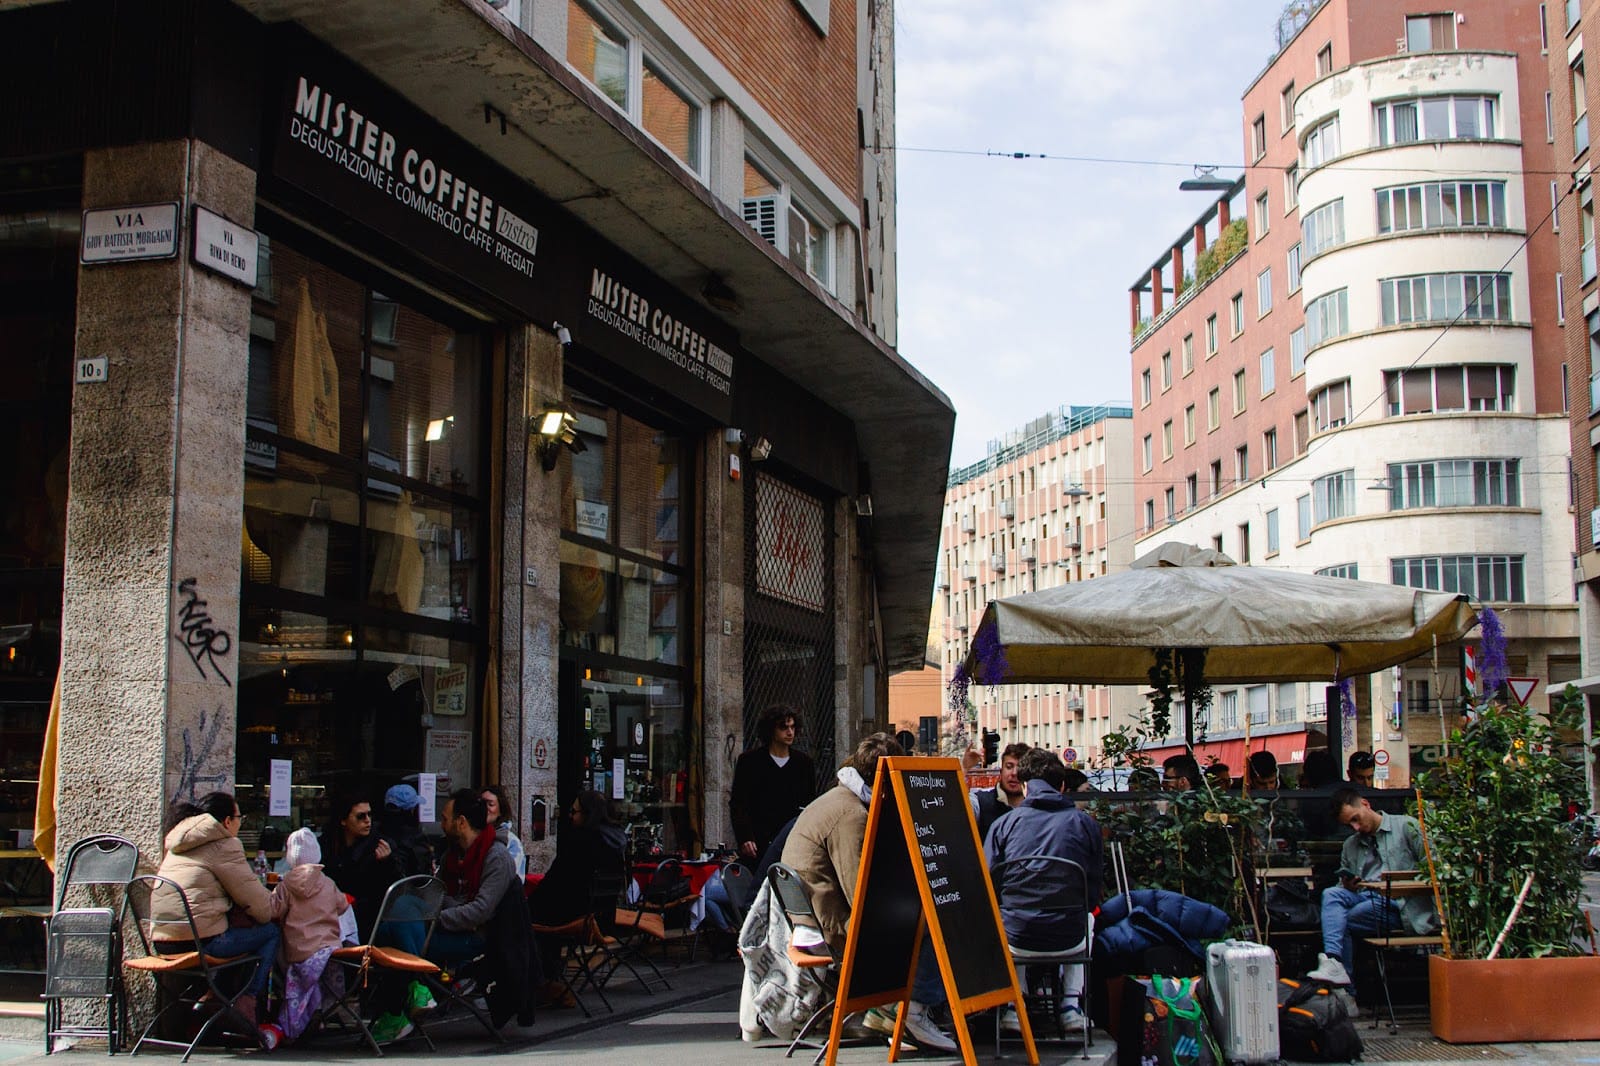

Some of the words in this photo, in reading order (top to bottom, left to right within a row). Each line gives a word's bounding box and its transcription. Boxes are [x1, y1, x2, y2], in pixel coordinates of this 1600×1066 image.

[295, 77, 396, 171] MISTER
[403, 149, 493, 231] COFFEE
[291, 117, 385, 189] DEGUSTAZIONE
[386, 175, 394, 195] E
[395, 182, 462, 234] COMMERCIO
[495, 242, 535, 278] PREGIATI
[116, 213, 145, 228] VIA
[104, 232, 133, 248] BATTISTA
[136, 229, 172, 245] MORGAGNI
[223, 230, 234, 246] VIA
[210, 243, 222, 261] RIVA
[230, 252, 246, 271] RENO
[591, 268, 649, 328] MISTER
[652, 308, 706, 363] COFFEE
[588, 299, 641, 343] DEGUSTAZIONE
[641, 331, 647, 346] E
[647, 335, 687, 369] COMMERCIO
[706, 370, 730, 396] PREGIATI
[82, 363, 94, 377] 10
